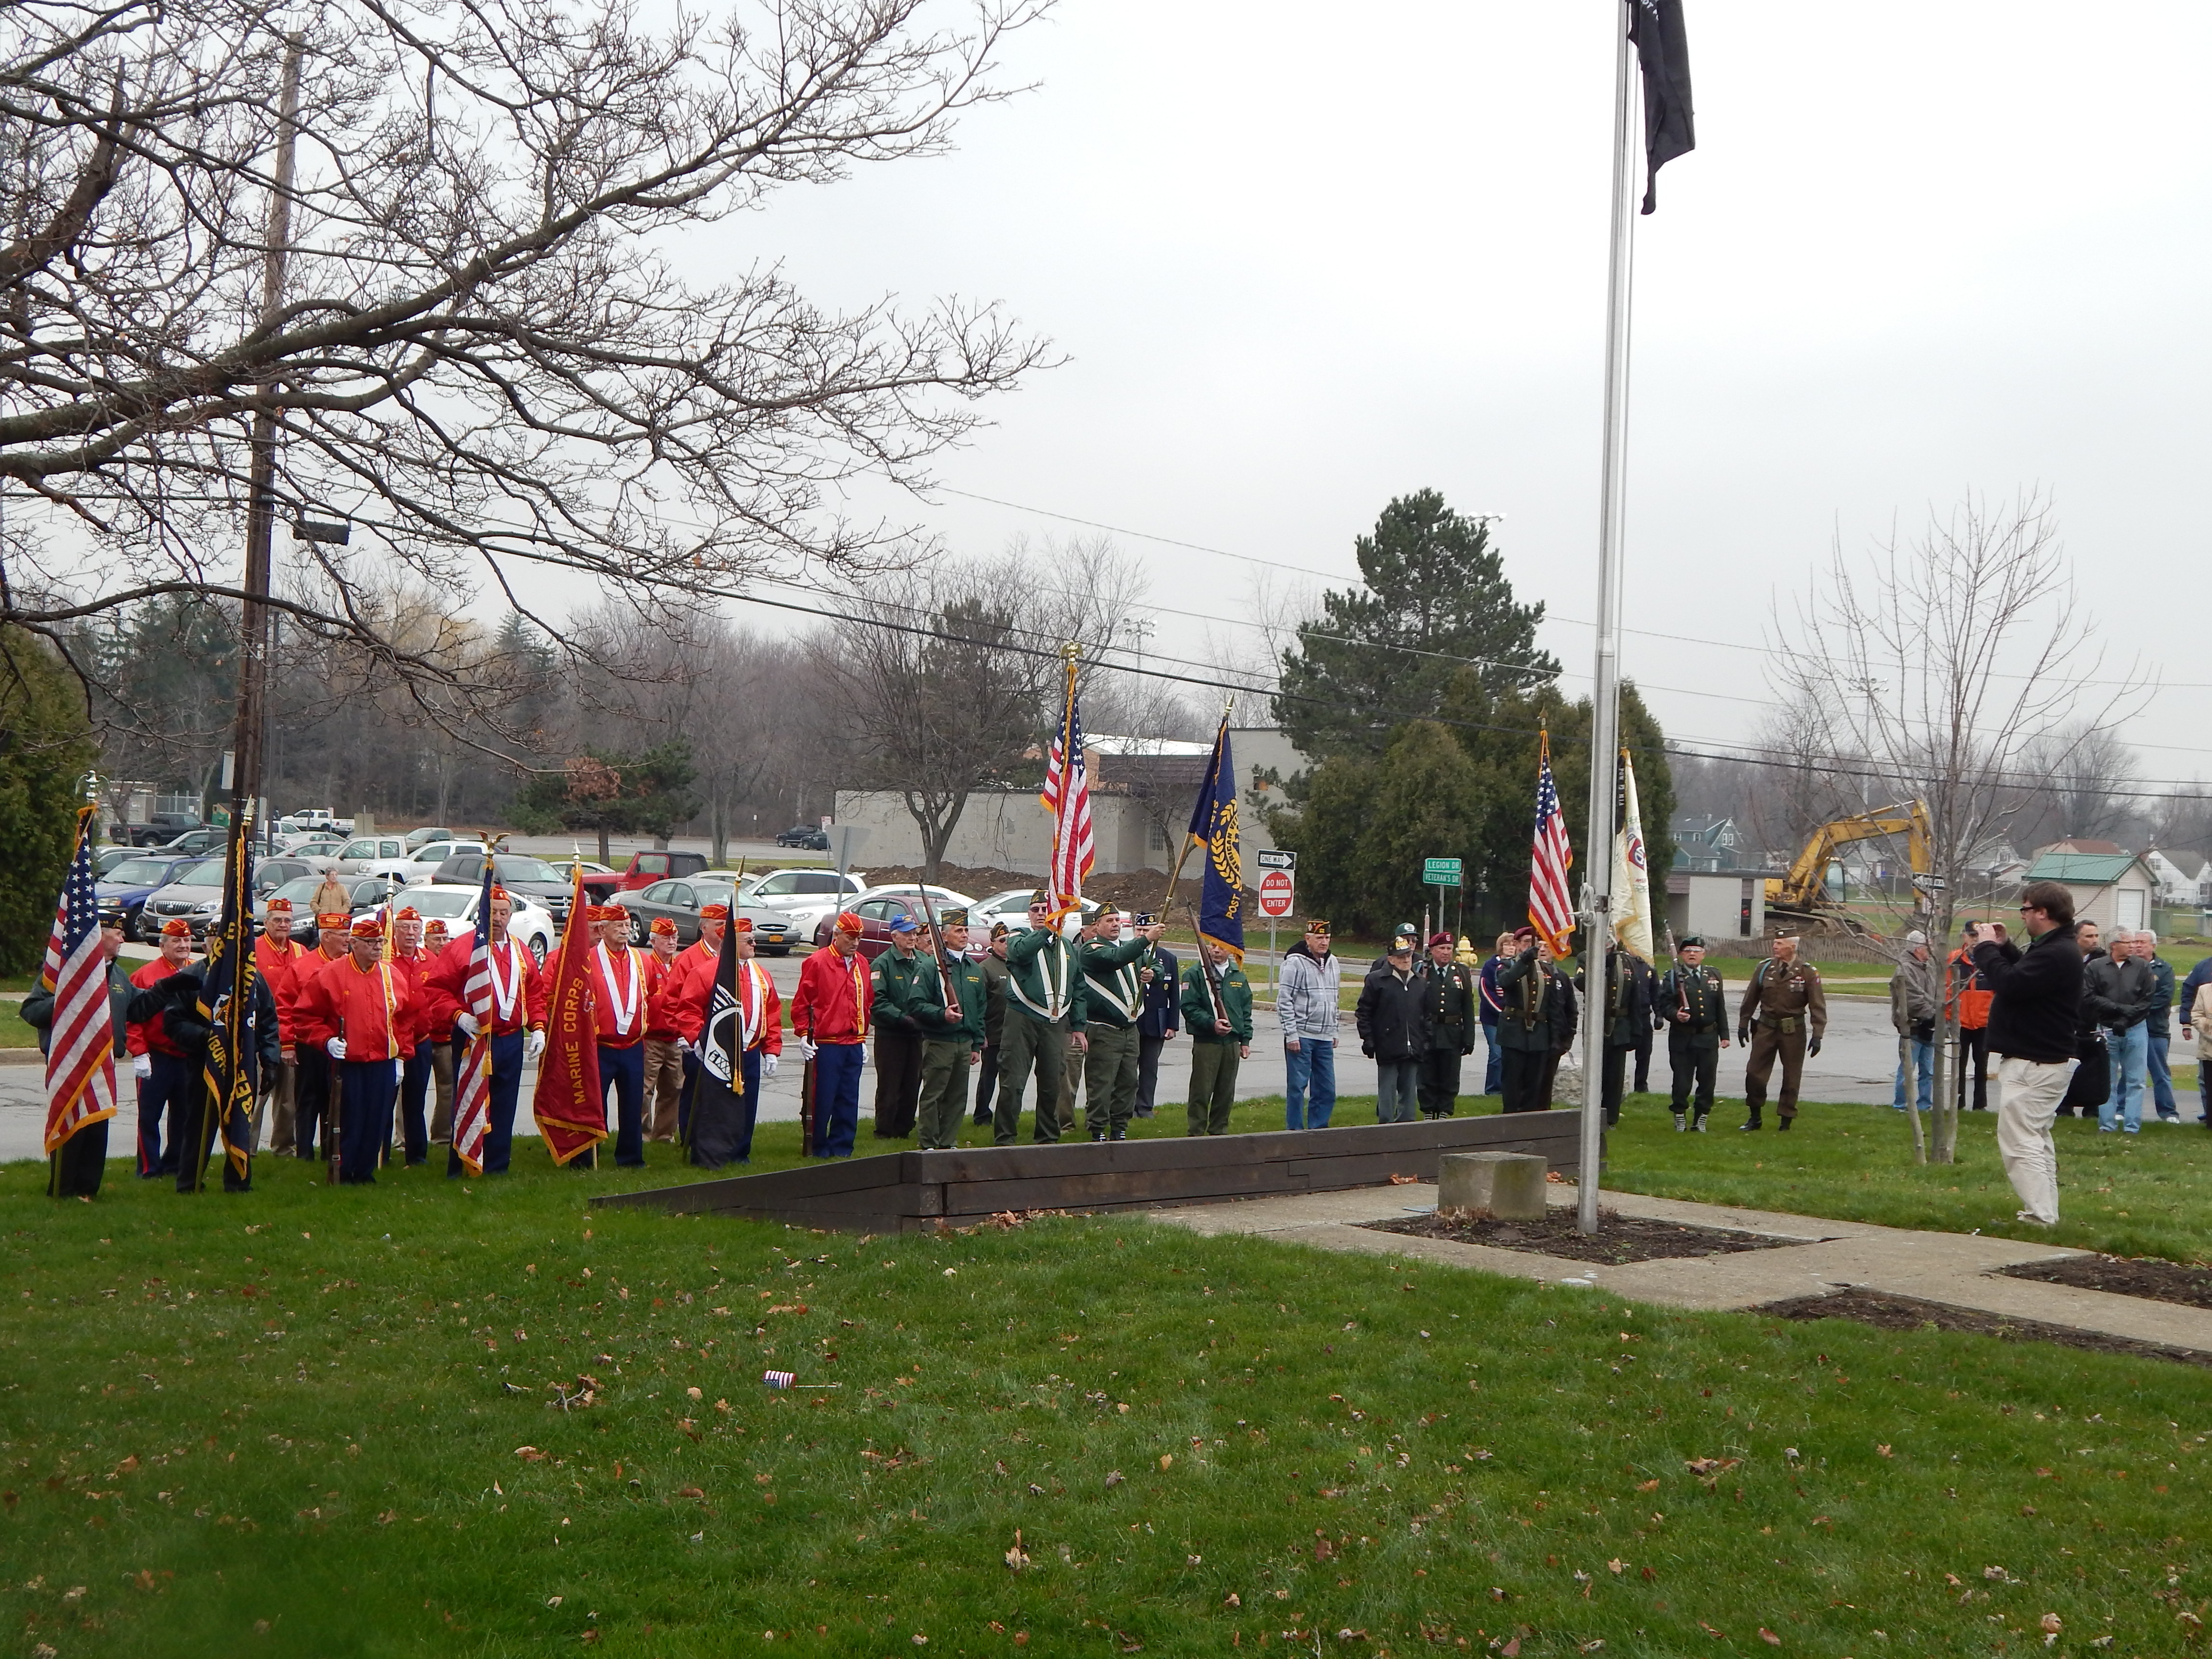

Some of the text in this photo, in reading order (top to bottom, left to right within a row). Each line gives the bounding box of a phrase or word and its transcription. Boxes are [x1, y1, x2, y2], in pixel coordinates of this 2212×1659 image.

[1640, 0, 1654, 8] OT
[1452, 875, 1459, 883] DR
[1225, 893, 1240, 920] POST
[563, 977, 586, 1105] MARINE CORPS
